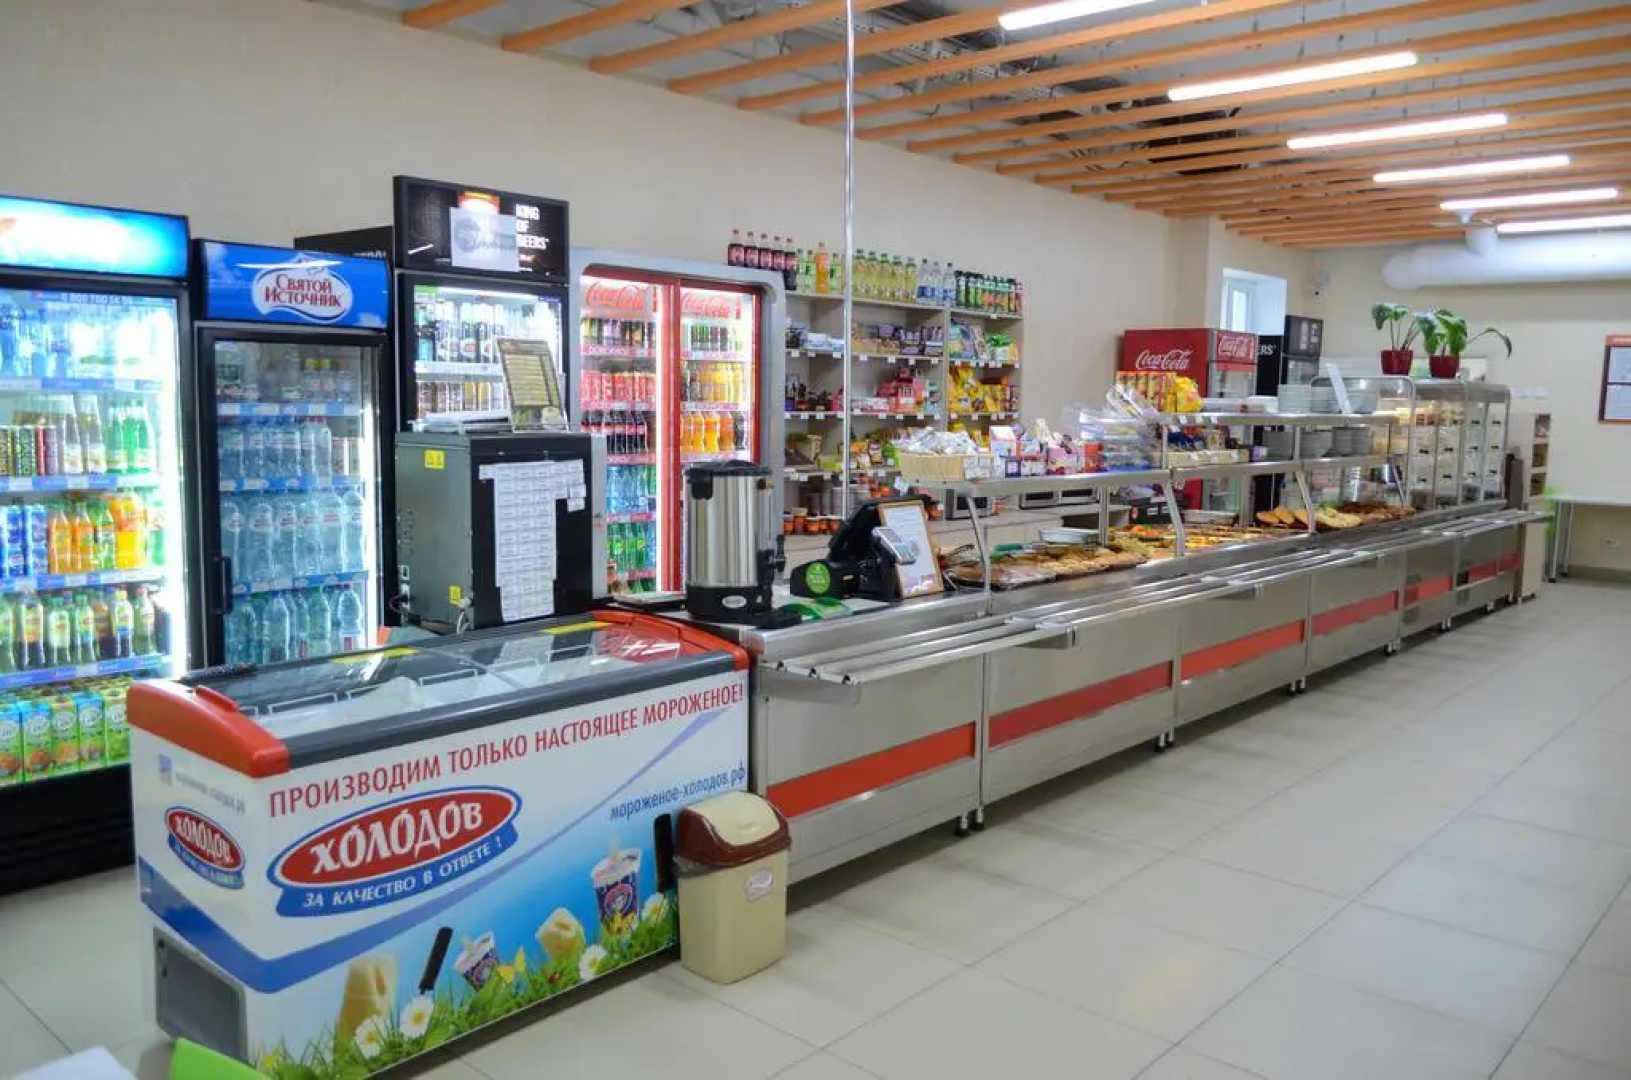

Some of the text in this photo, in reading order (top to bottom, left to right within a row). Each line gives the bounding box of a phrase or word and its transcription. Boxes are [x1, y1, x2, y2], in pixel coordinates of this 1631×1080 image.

[516, 203, 541, 220] KING
[516, 219, 530, 233] OF
[1135, 349, 1193, 371] Coca-Cola
[269, 754, 441, 818] ПРОИЗВОДИМ
[447, 734, 528, 773] ТОЛЬКО
[534, 708, 638, 752] НАСТОЯЩЕЕ
[642, 682, 744, 726] МОРОЖЕНОЕ!
[610, 759, 746, 821] мороженое-холодов.рф
[310, 800, 483, 875] ХОЛОДОВ
[303, 892, 324, 908] ЗА
[332, 875, 417, 906] КАЧЕСТВО
[423, 870, 433, 884] В
[439, 843, 492, 878] ОТВЕТЕ
